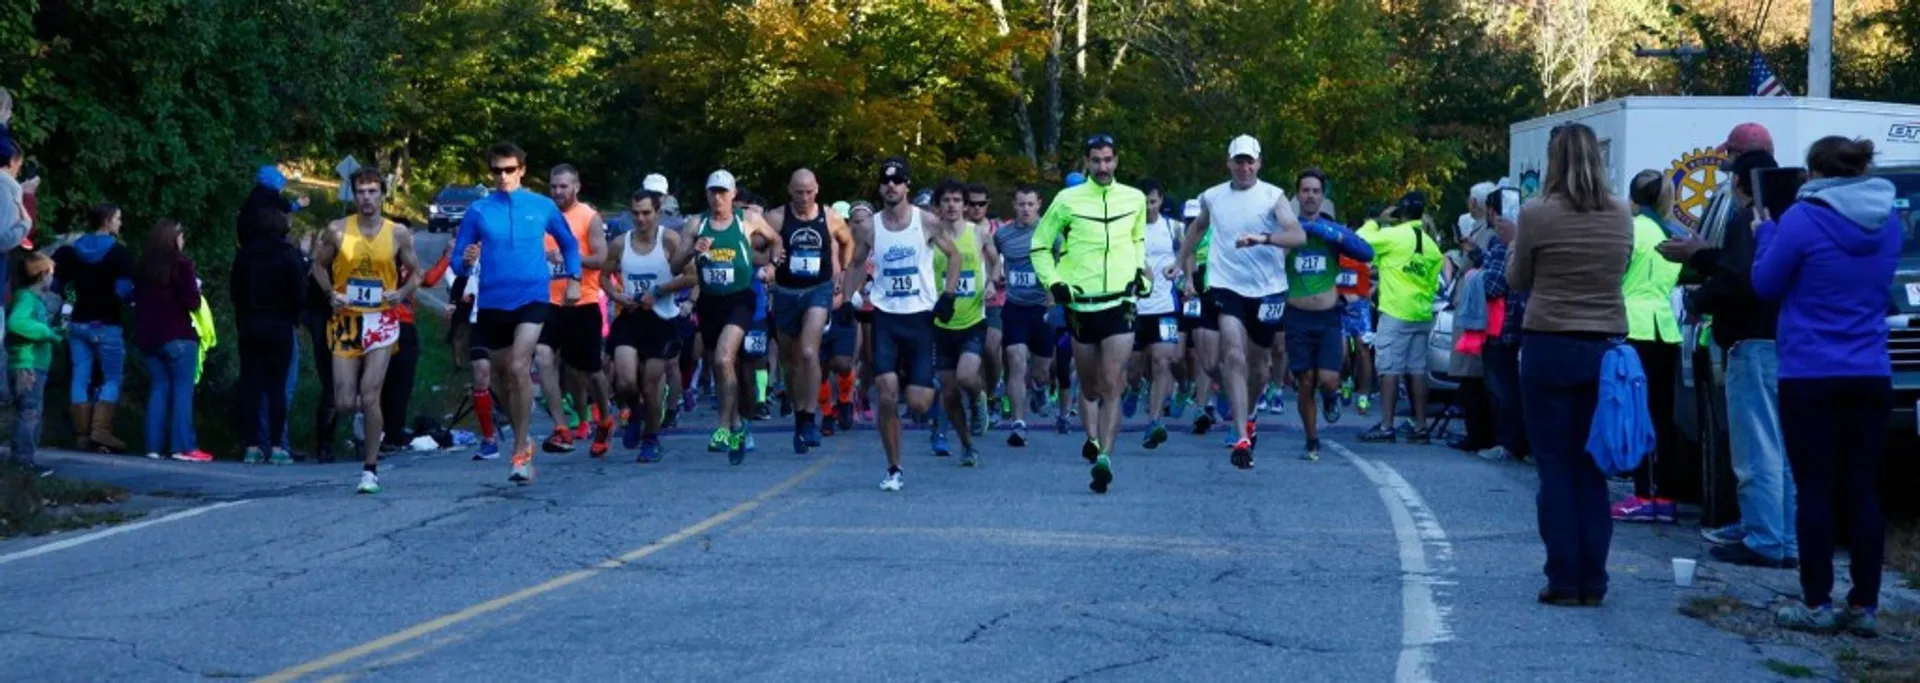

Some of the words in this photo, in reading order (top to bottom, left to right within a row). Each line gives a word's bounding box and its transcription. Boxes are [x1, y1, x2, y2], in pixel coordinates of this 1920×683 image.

[803, 258, 808, 270] 1
[1302, 257, 1319, 269] 217
[892, 276, 912, 290] 219
